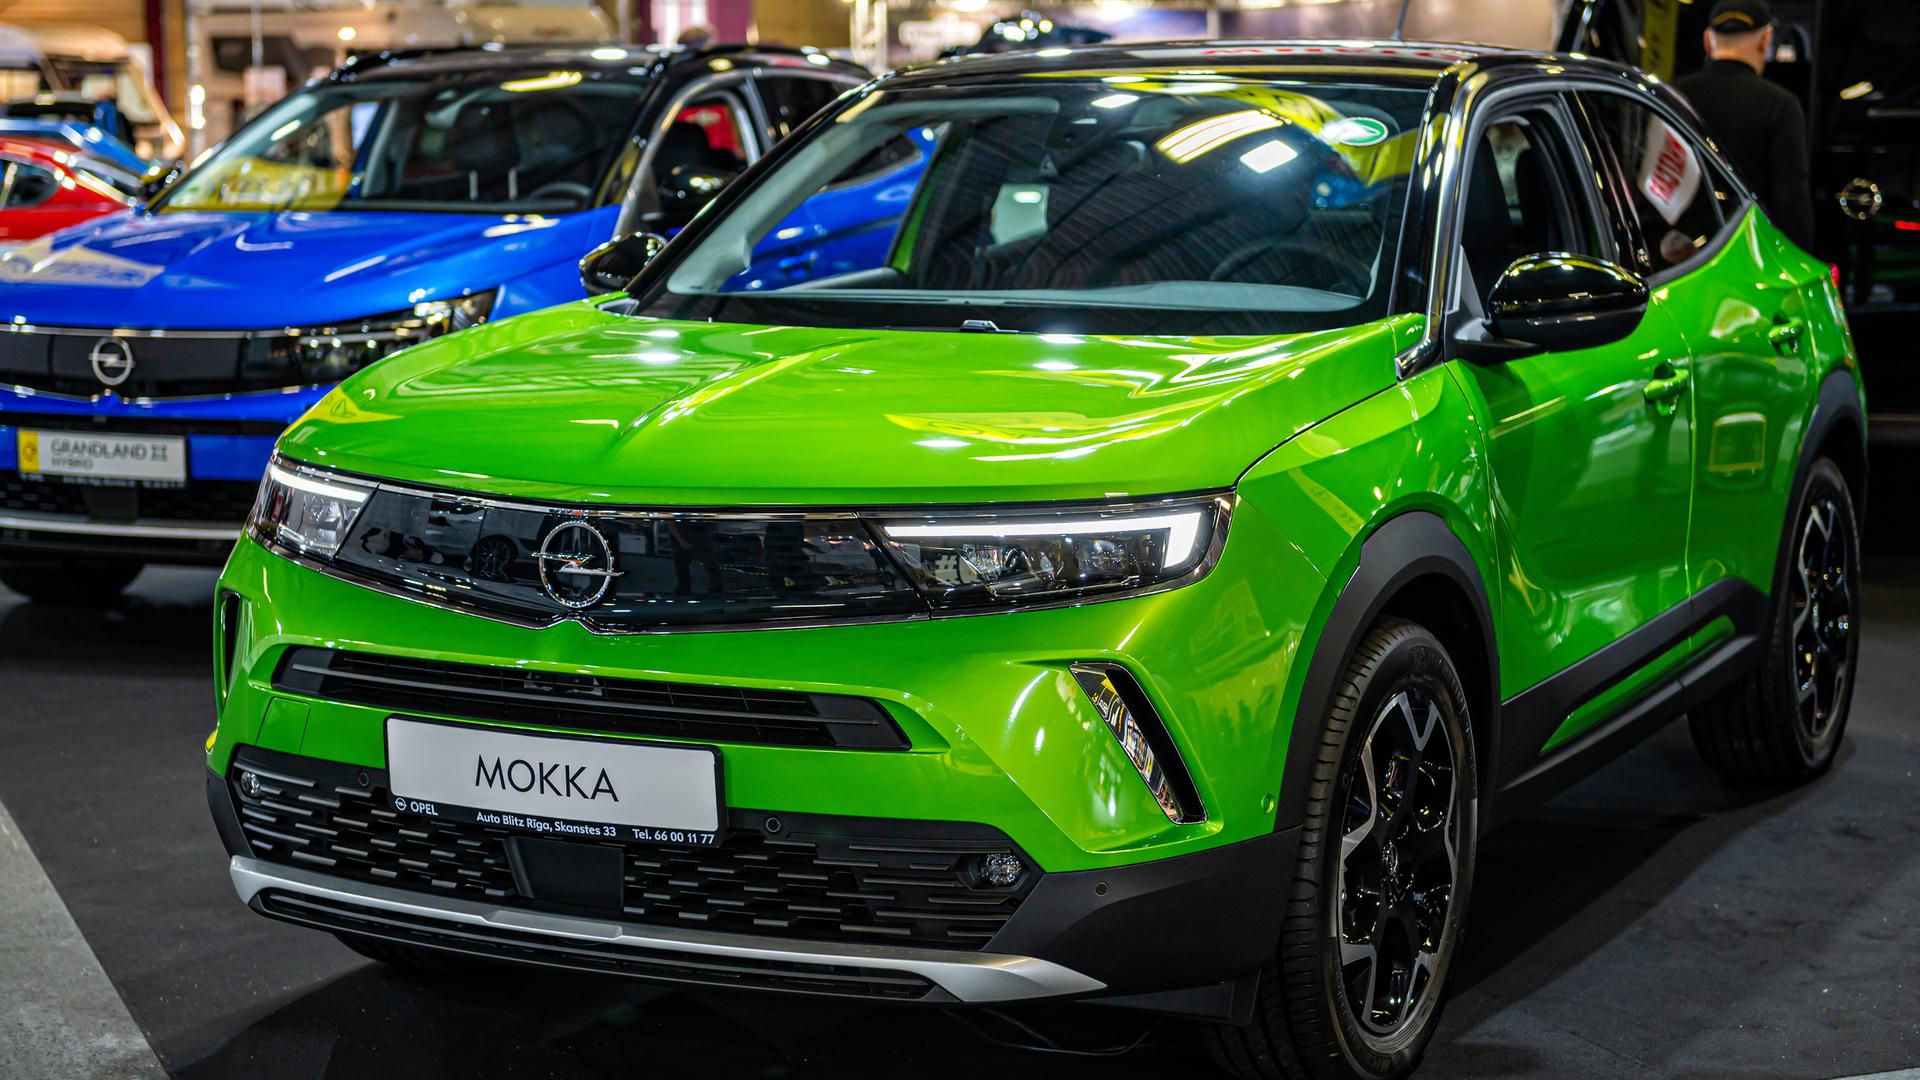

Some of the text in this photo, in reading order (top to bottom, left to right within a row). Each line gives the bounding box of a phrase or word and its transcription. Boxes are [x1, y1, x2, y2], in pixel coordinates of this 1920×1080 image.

[51, 438, 148, 461] GRANDLAND
[475, 754, 619, 802] MOKKA
[410, 801, 439, 816] OPEL
[476, 811, 617, 837] Auto Blitz Rīga, Skanstes 33
[632, 828, 714, 844] Tel. 66 00 11 77
